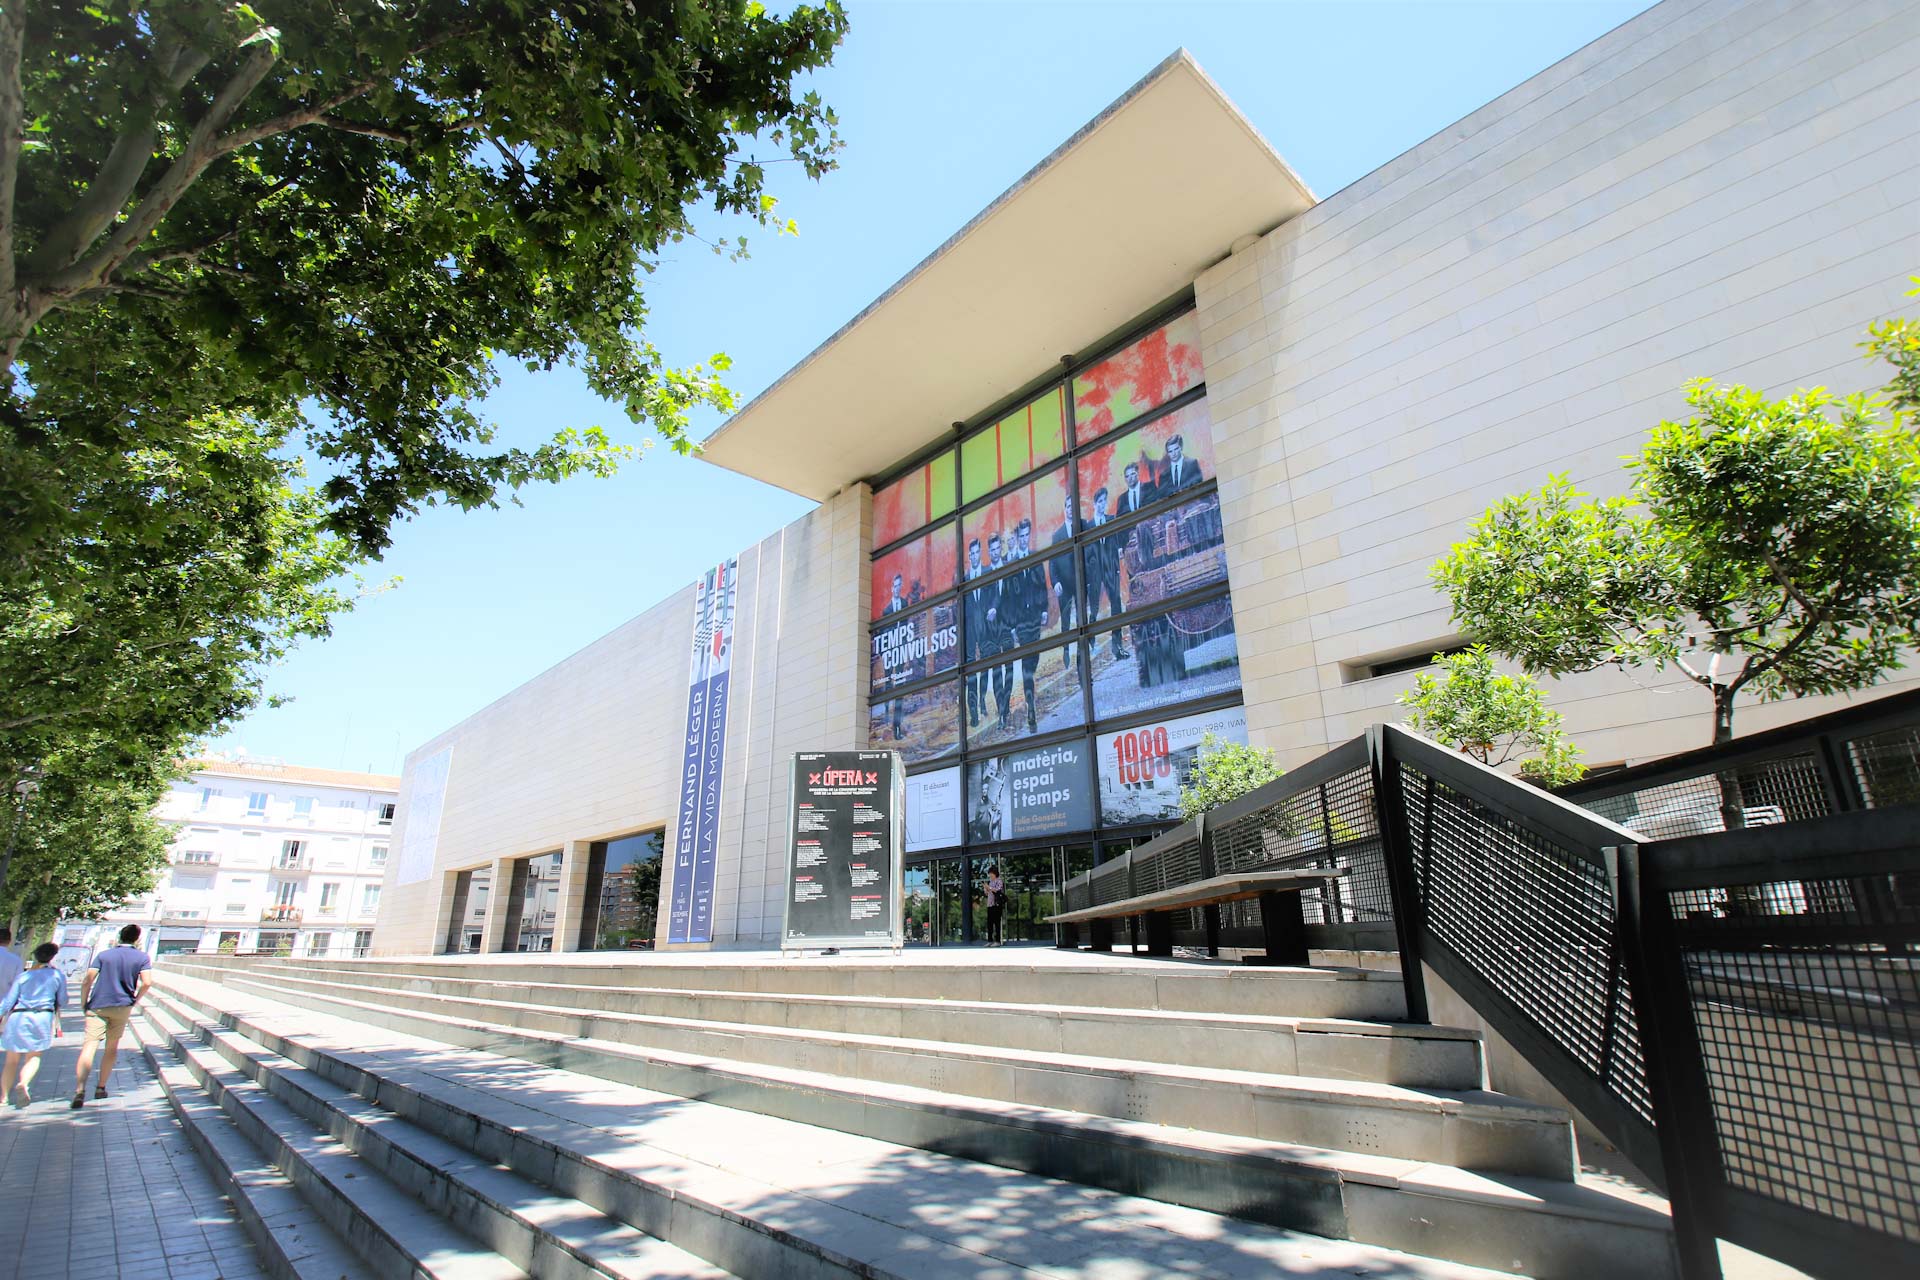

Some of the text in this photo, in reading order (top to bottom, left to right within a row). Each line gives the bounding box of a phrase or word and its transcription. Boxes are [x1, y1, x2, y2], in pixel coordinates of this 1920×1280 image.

[873, 622, 915, 655] TEMPS
[882, 626, 958, 670] CONVULSOS
[709, 681, 724, 775] MODERNA
[1012, 747, 1078, 773] matèria,
[1113, 726, 1171, 784] 1989
[680, 690, 703, 867] FERNAND LÉGER
[823, 765, 864, 786] ÓPERA
[1013, 767, 1054, 793] espai
[704, 780, 717, 824] VIDA
[1013, 788, 1071, 809] i temps
[702, 829, 713, 853] LA
